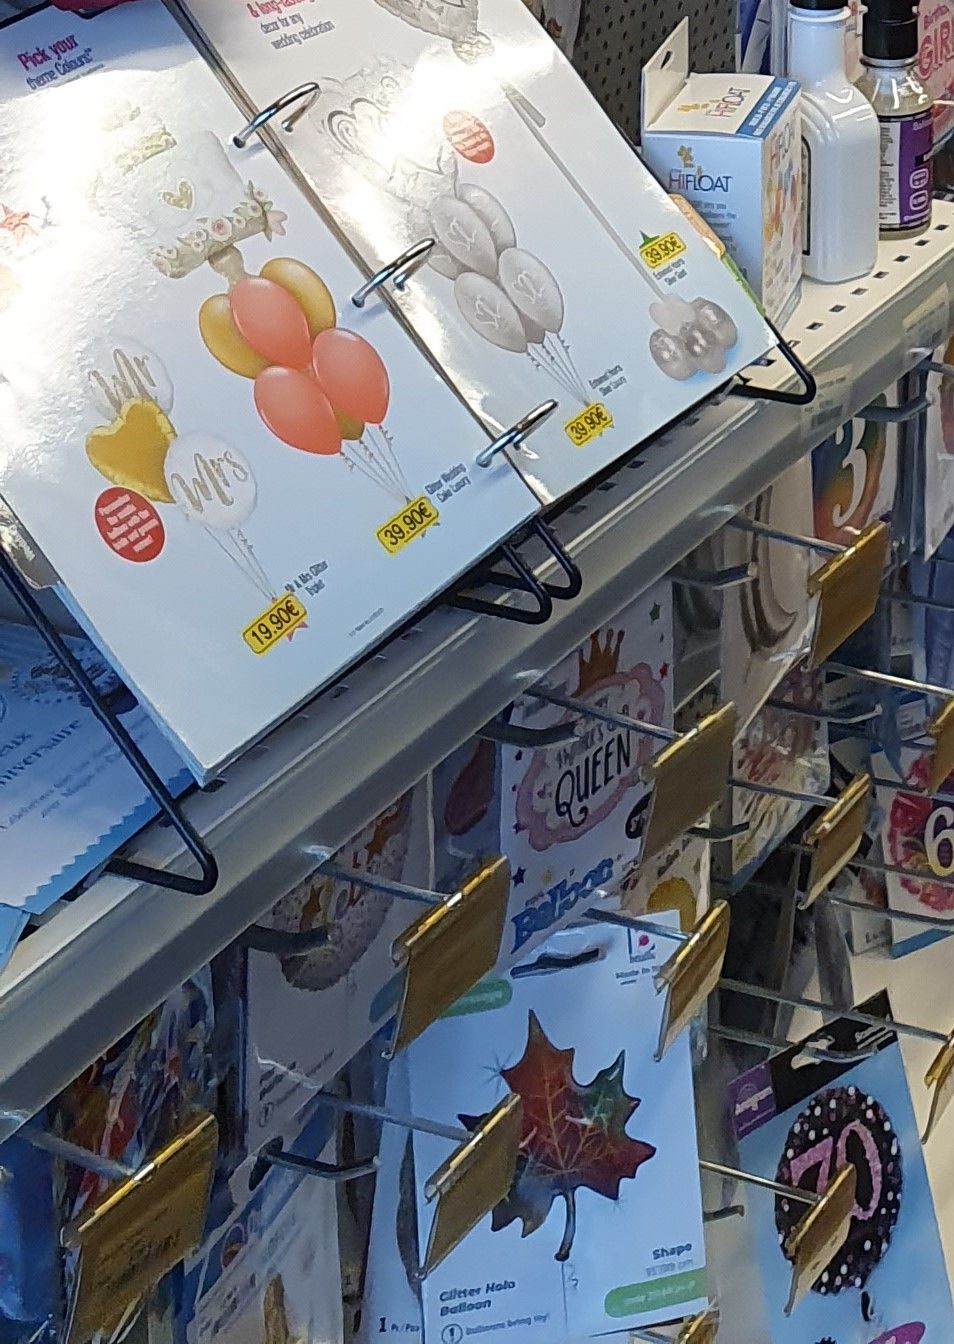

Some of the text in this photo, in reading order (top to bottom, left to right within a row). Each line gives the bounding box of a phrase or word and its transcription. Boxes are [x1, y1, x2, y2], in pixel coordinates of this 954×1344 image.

[17, 33, 80, 71] Pick your
[271, 20, 336, 50] wedding celebration
[26, 70, 54, 91] theme
[669, 172, 734, 194] HIFLOAT
[644, 233, 680, 265] 39.90€
[87, 347, 157, 414] Mr
[569, 406, 609, 441] 39.90€
[170, 450, 249, 514] Mrs
[384, 500, 433, 546] 39.90€
[251, 598, 300, 646] 19.90€
[555, 732, 631, 828] QUEEN
[789, 1119, 883, 1222] 70
[651, 1241, 693, 1262] Shape
[439, 1278, 516, 1303] Glitter Holo
[440, 1297, 492, 1318] Balloon
